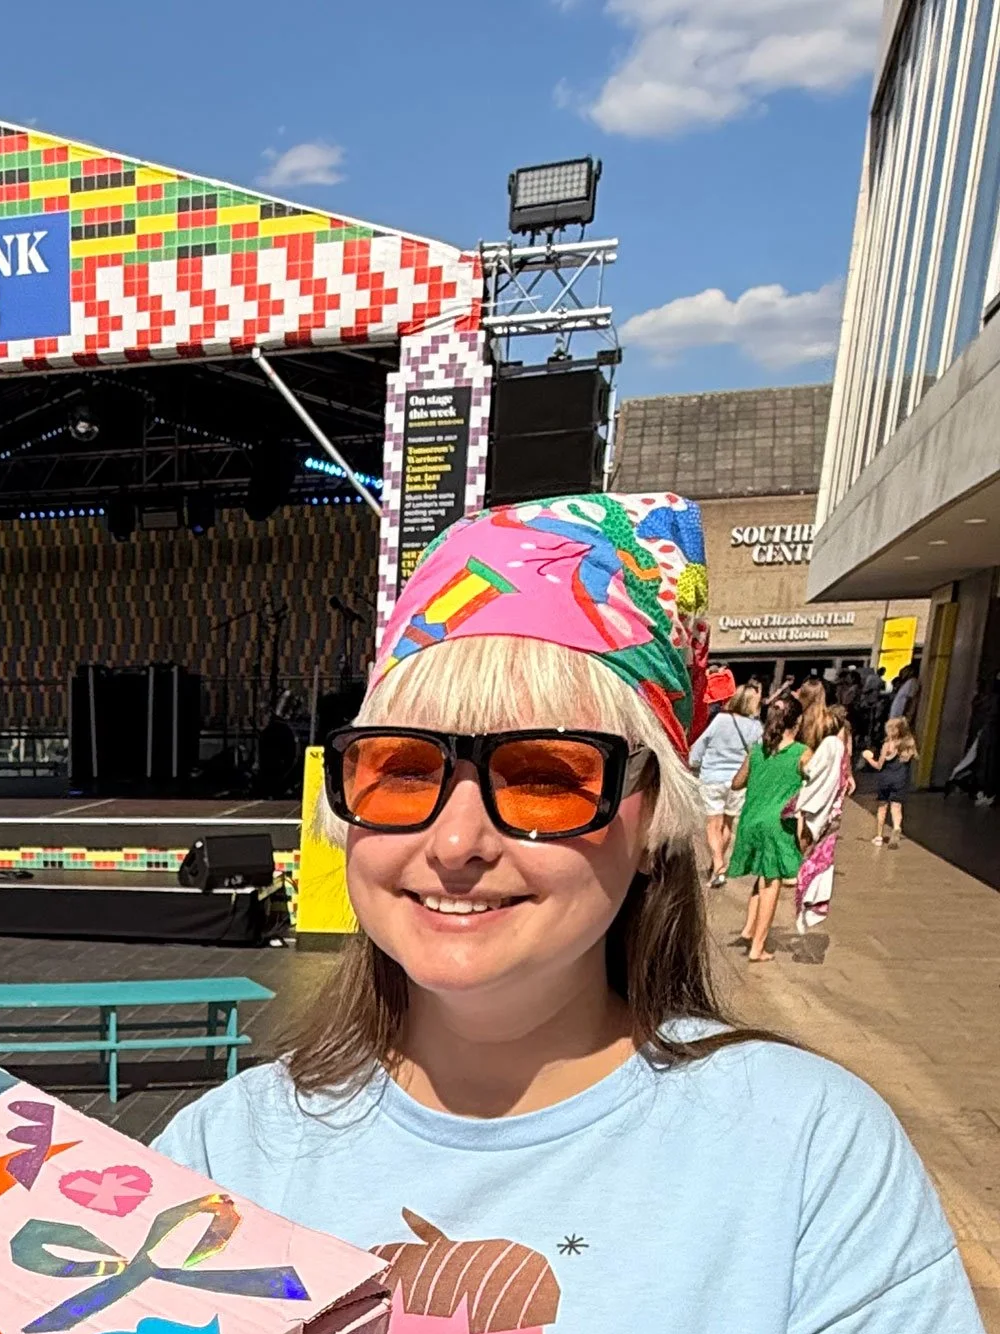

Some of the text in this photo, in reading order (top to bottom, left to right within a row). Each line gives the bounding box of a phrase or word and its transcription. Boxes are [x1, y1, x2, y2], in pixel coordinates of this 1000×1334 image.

[409, 394, 452, 406] On stage
[408, 405, 456, 419] this week
[719, 612, 855, 630] Queen Elizabeth Hall
[740, 628, 829, 642] Purcell Room
